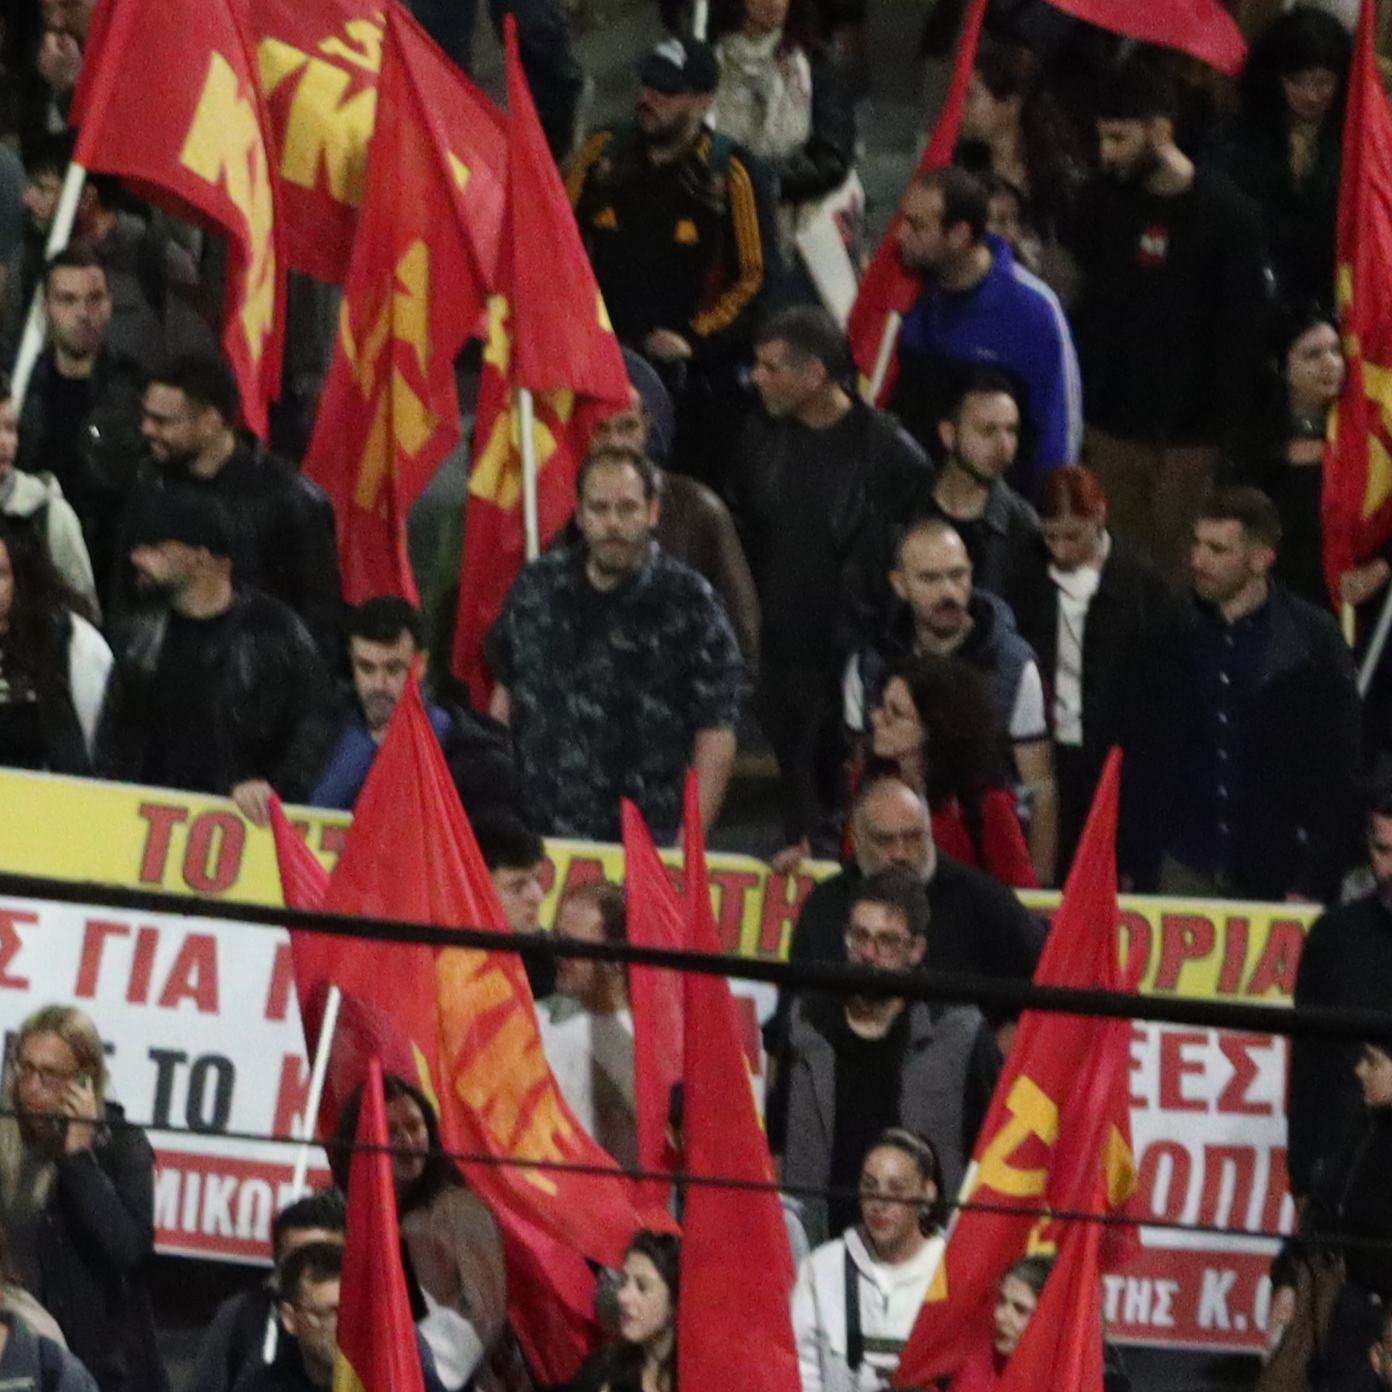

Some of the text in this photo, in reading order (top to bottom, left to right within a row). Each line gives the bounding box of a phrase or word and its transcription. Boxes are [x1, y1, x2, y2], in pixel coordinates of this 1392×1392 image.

[139, 803, 246, 892] ΤΟ
[1119, 910, 1304, 996] ΟΡΙΑ
[74, 919, 221, 1016] ΓΙΑ
[149, 1048, 236, 1135] ΤΟ
